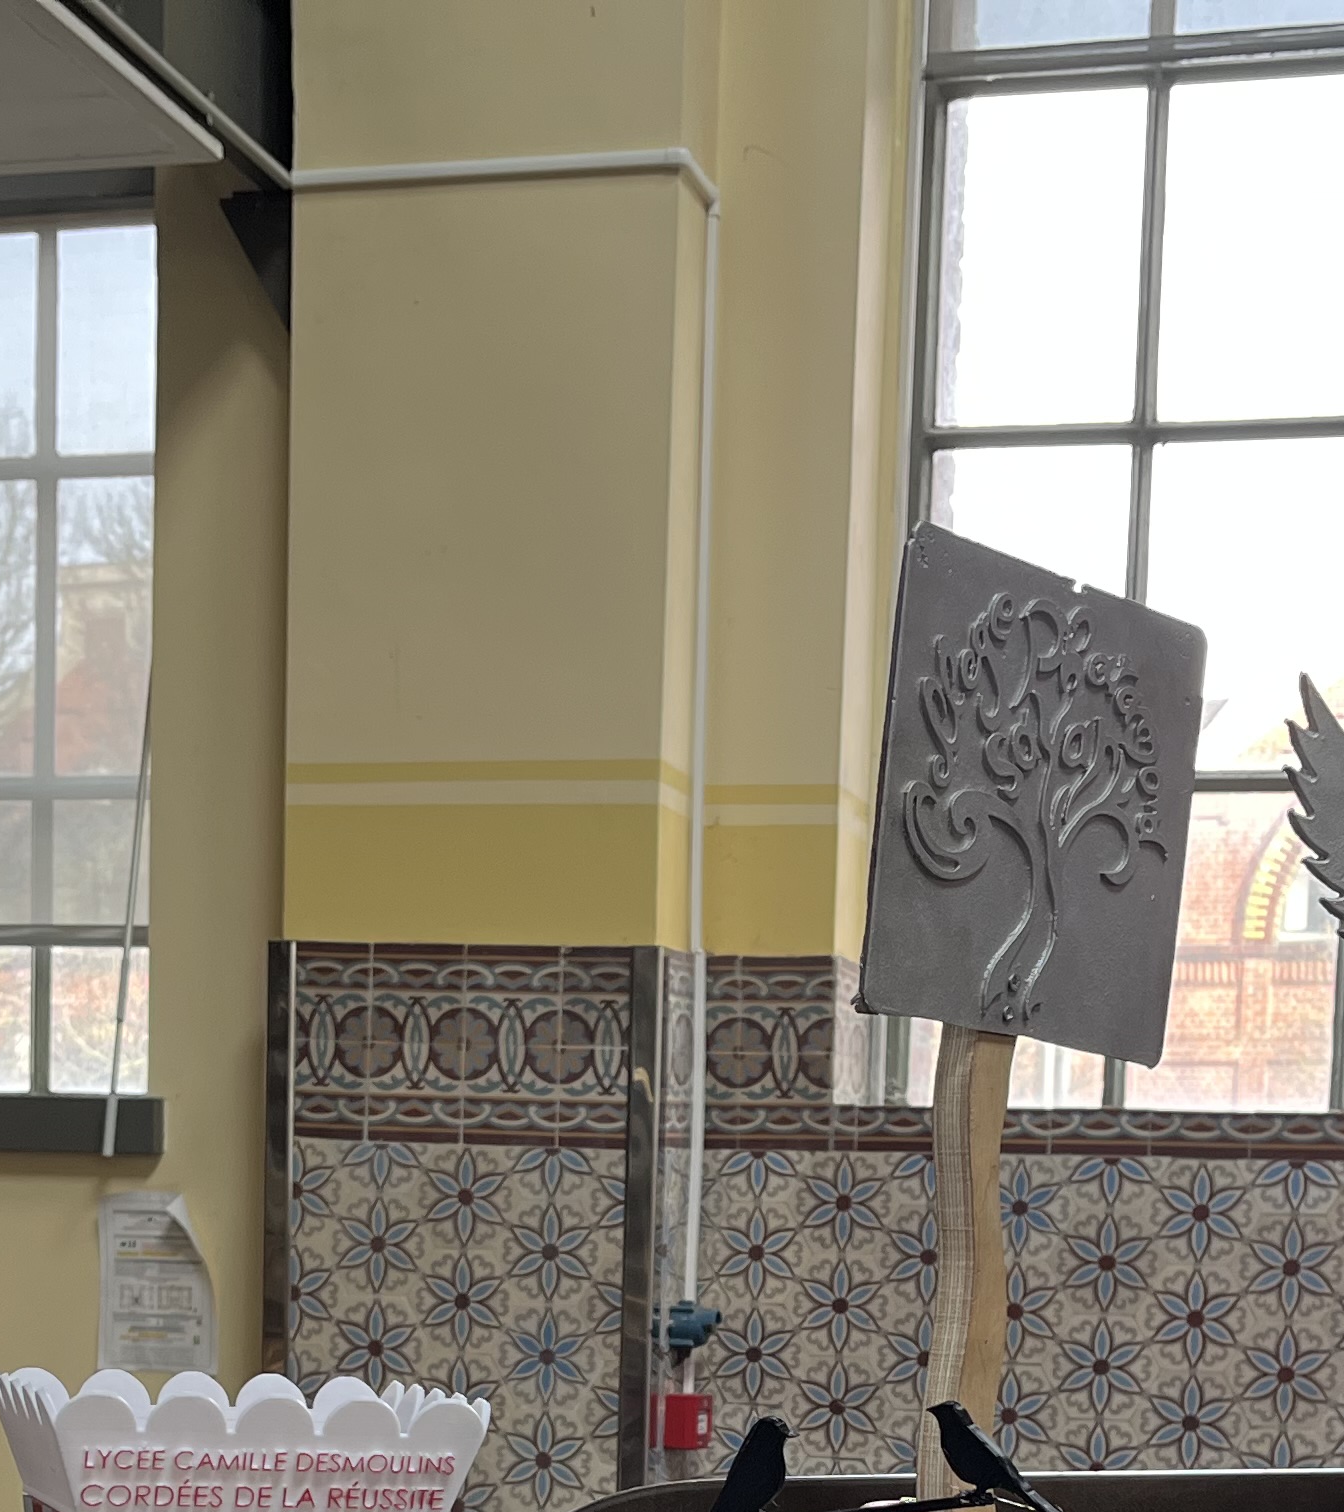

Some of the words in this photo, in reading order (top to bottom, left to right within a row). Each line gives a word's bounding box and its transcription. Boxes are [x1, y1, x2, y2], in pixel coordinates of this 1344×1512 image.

[83, 1443, 165, 1472] LYCÉE
[173, 1449, 287, 1474] CAMILLE
[295, 1450, 455, 1475] DESMOULINS
[80, 1479, 224, 1509] CORDÉES
[235, 1485, 272, 1509] DE
[281, 1486, 316, 1509] LA
[327, 1480, 446, 1511] RÉUSSITE
